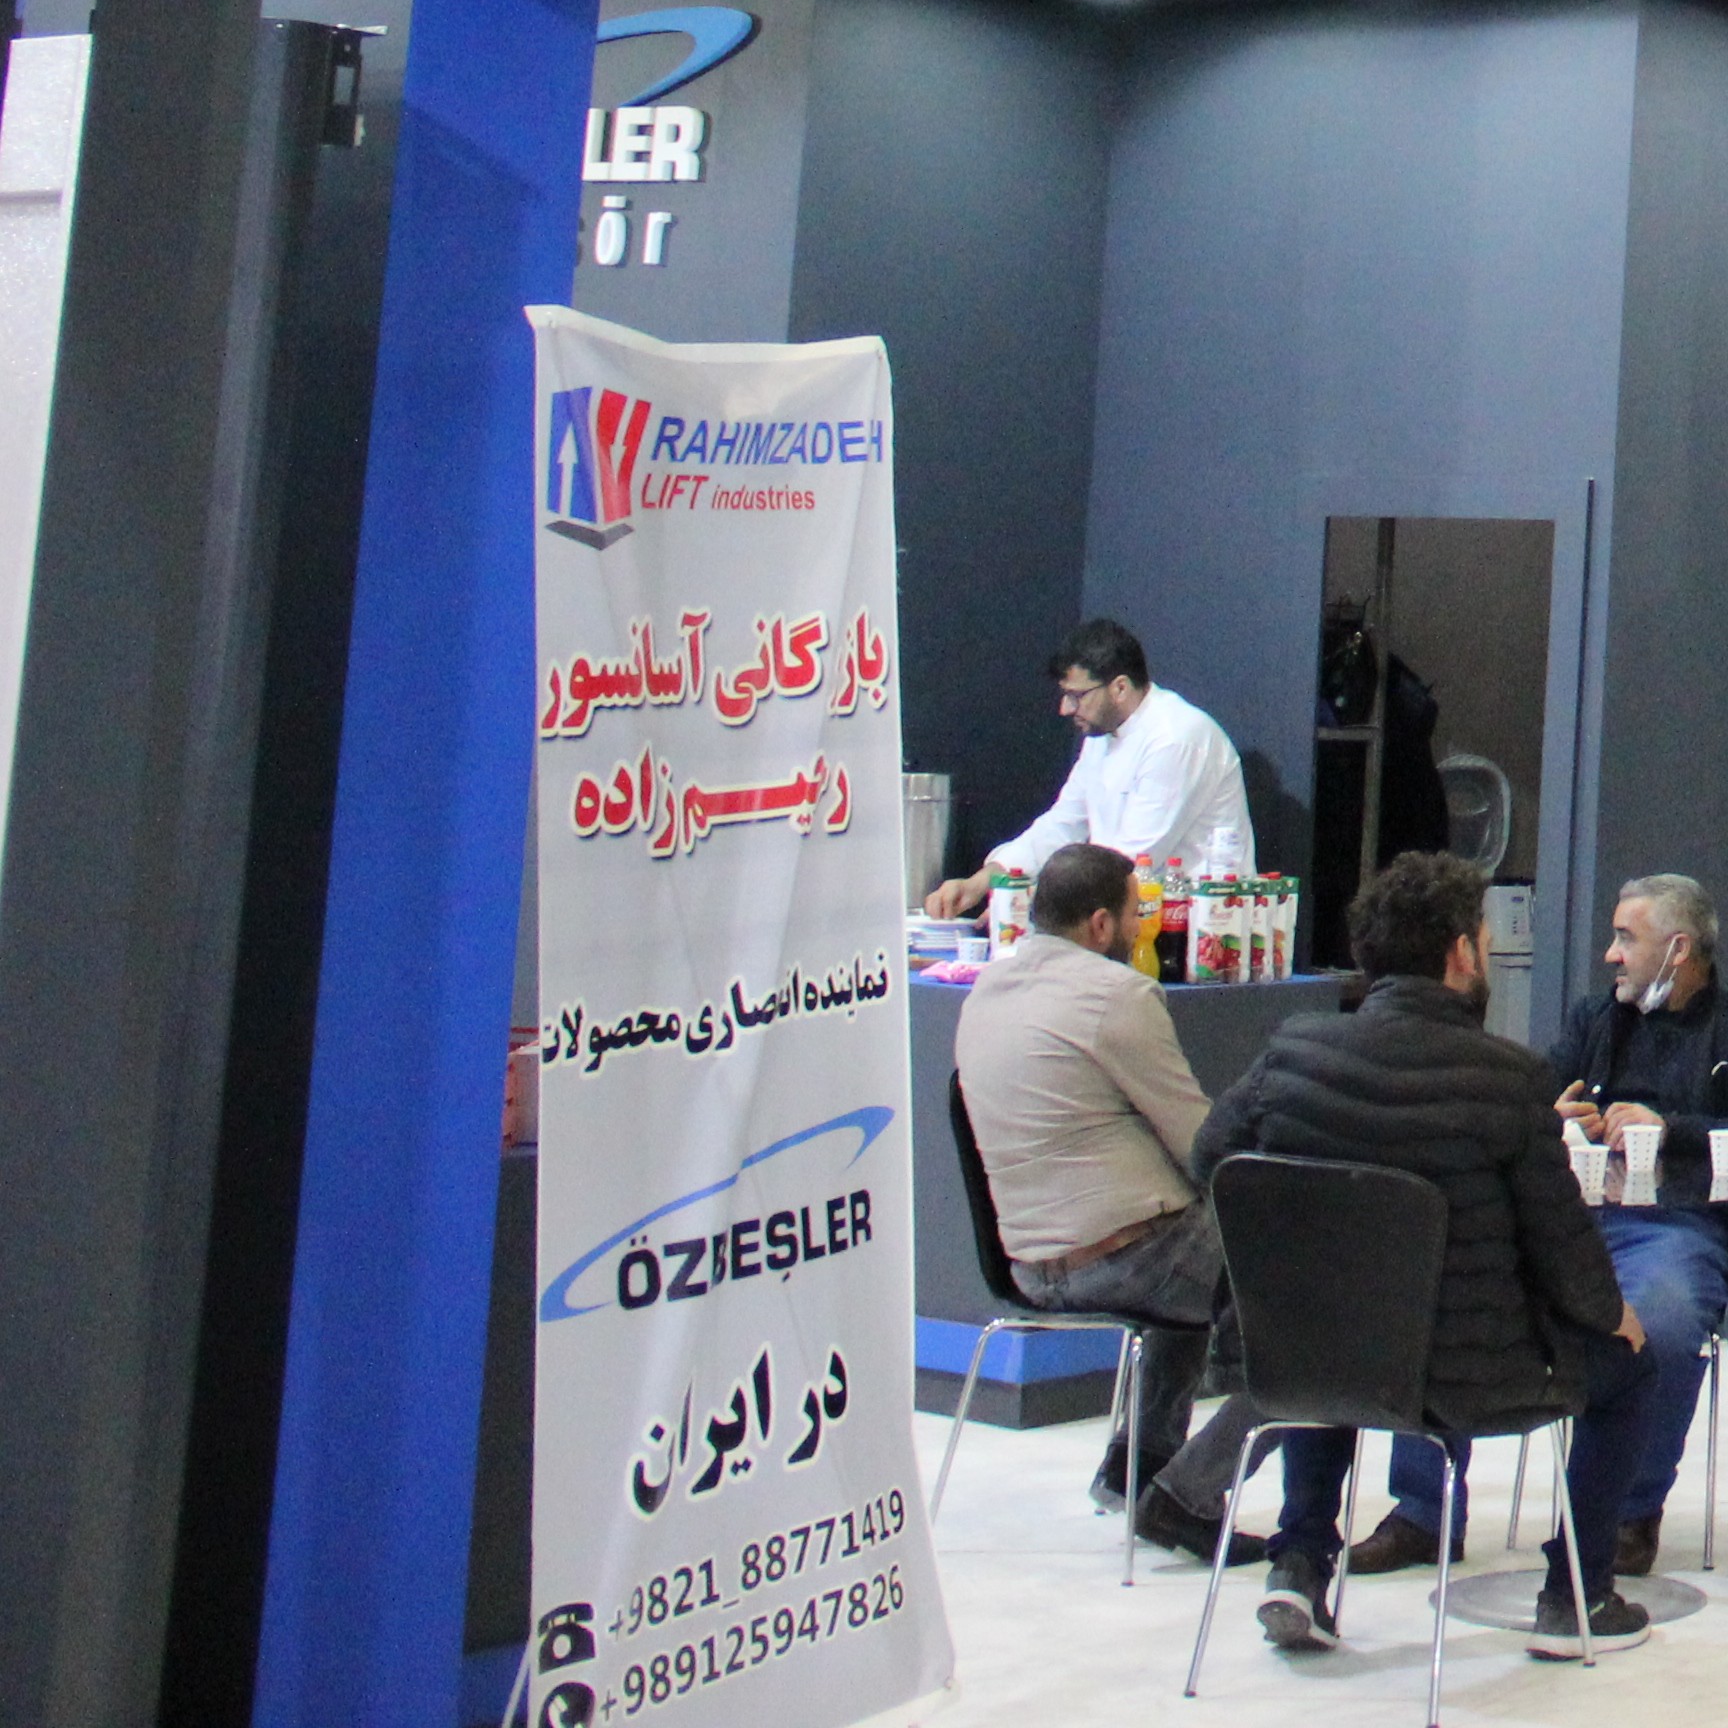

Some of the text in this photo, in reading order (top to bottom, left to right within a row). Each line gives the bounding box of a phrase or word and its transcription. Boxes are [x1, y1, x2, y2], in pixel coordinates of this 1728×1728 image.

[651, 416, 883, 465] RAHIMZADEH
[641, 473, 815, 510] LIFT industries
[631, 1346, 850, 1518] در ایران
